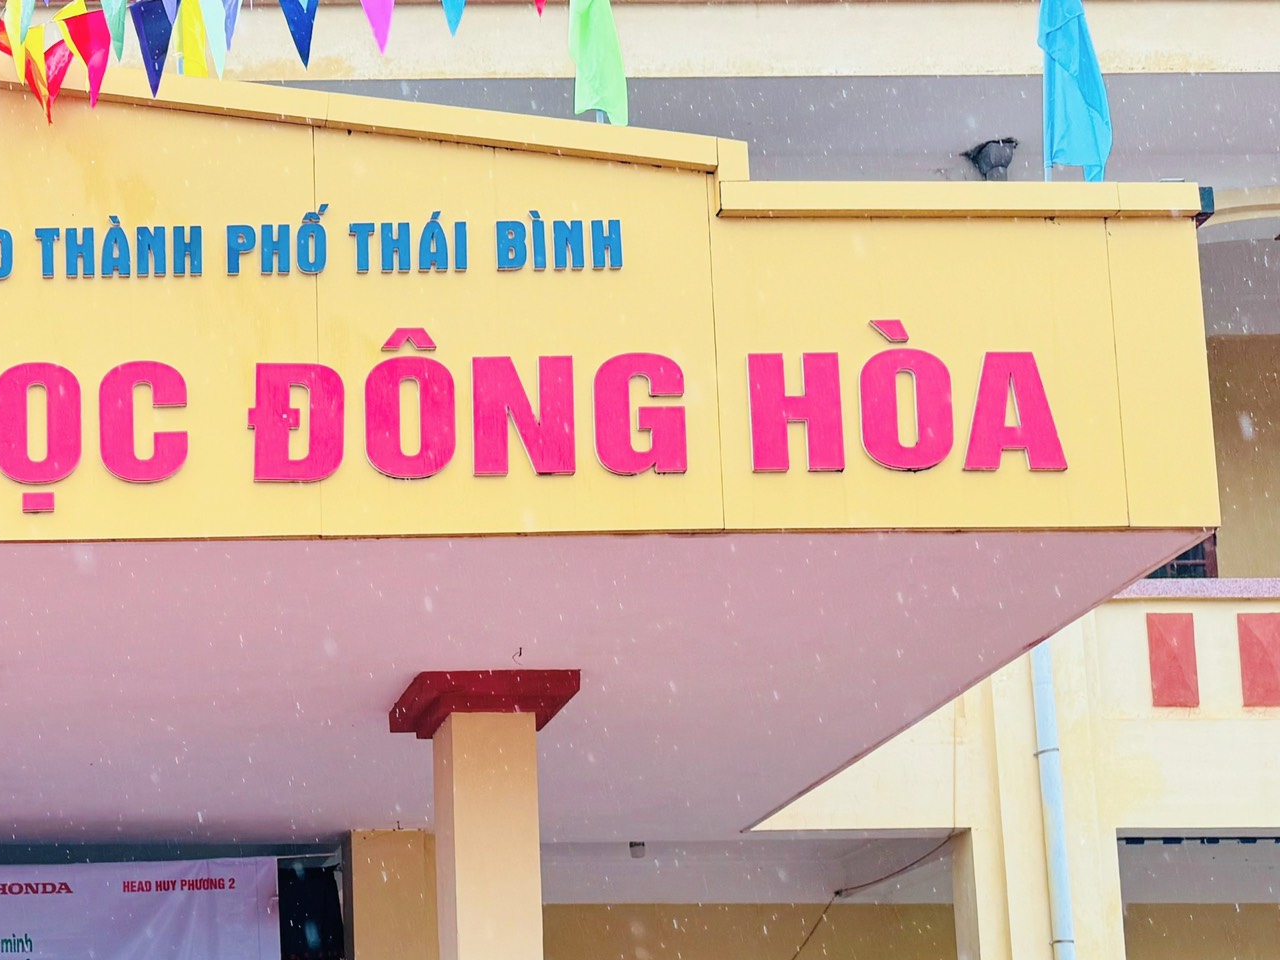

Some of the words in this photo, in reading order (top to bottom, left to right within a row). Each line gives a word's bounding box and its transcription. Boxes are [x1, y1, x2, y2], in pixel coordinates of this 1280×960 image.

[35, 216, 203, 278] THÀNH
[227, 204, 329, 275] PHỐ
[349, 211, 468, 273] THÁI
[496, 210, 624, 271] BÌNH
[247, 327, 688, 483] ĐÔNG
[748, 320, 1068, 474] HÒA
[123, 880, 151, 892] HEAD
[155, 879, 178, 892] HUY
[180, 877, 225, 891] PHƯƠNG
[229, 878, 236, 890] 2
[1, 933, 33, 953] mình
